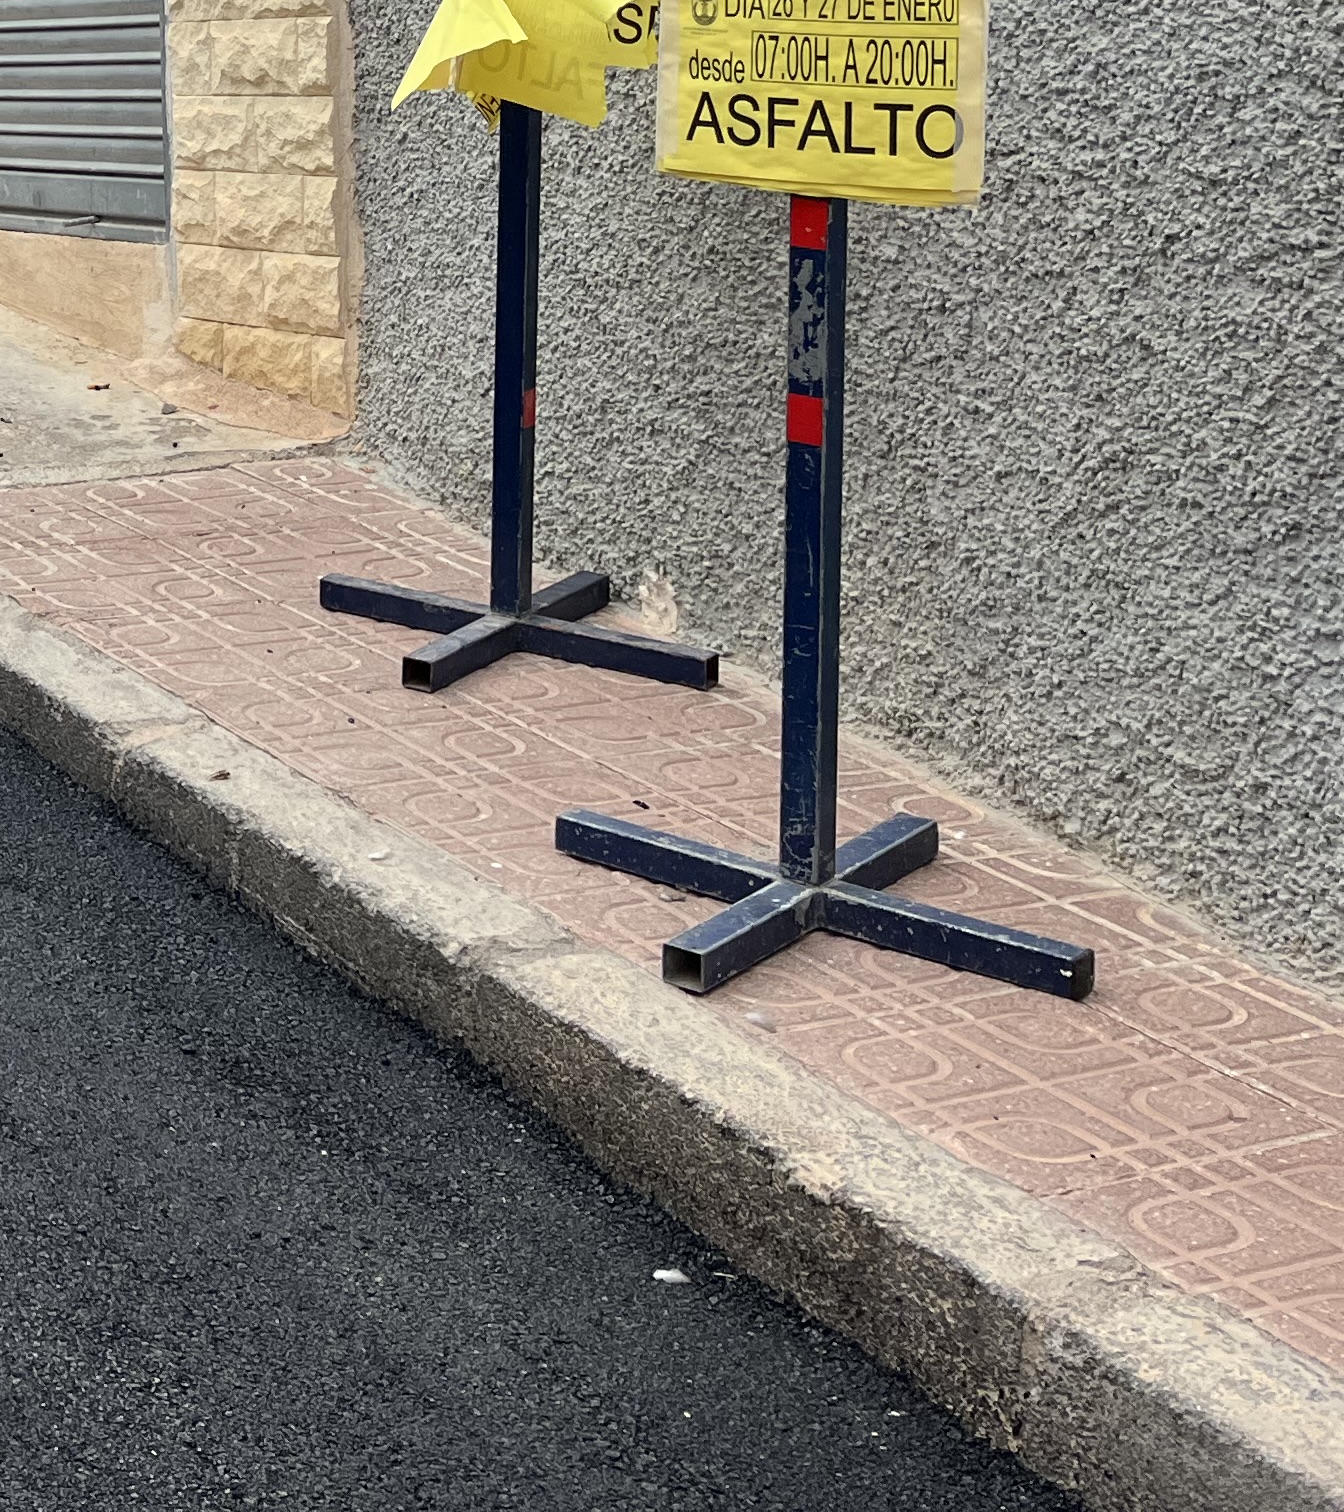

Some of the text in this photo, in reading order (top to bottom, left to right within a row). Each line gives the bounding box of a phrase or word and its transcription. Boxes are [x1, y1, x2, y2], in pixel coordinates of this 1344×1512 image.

[689, 33, 954, 87] desde 07:00H. A 20:00H.
[685, 91, 964, 159] ASFALTO
